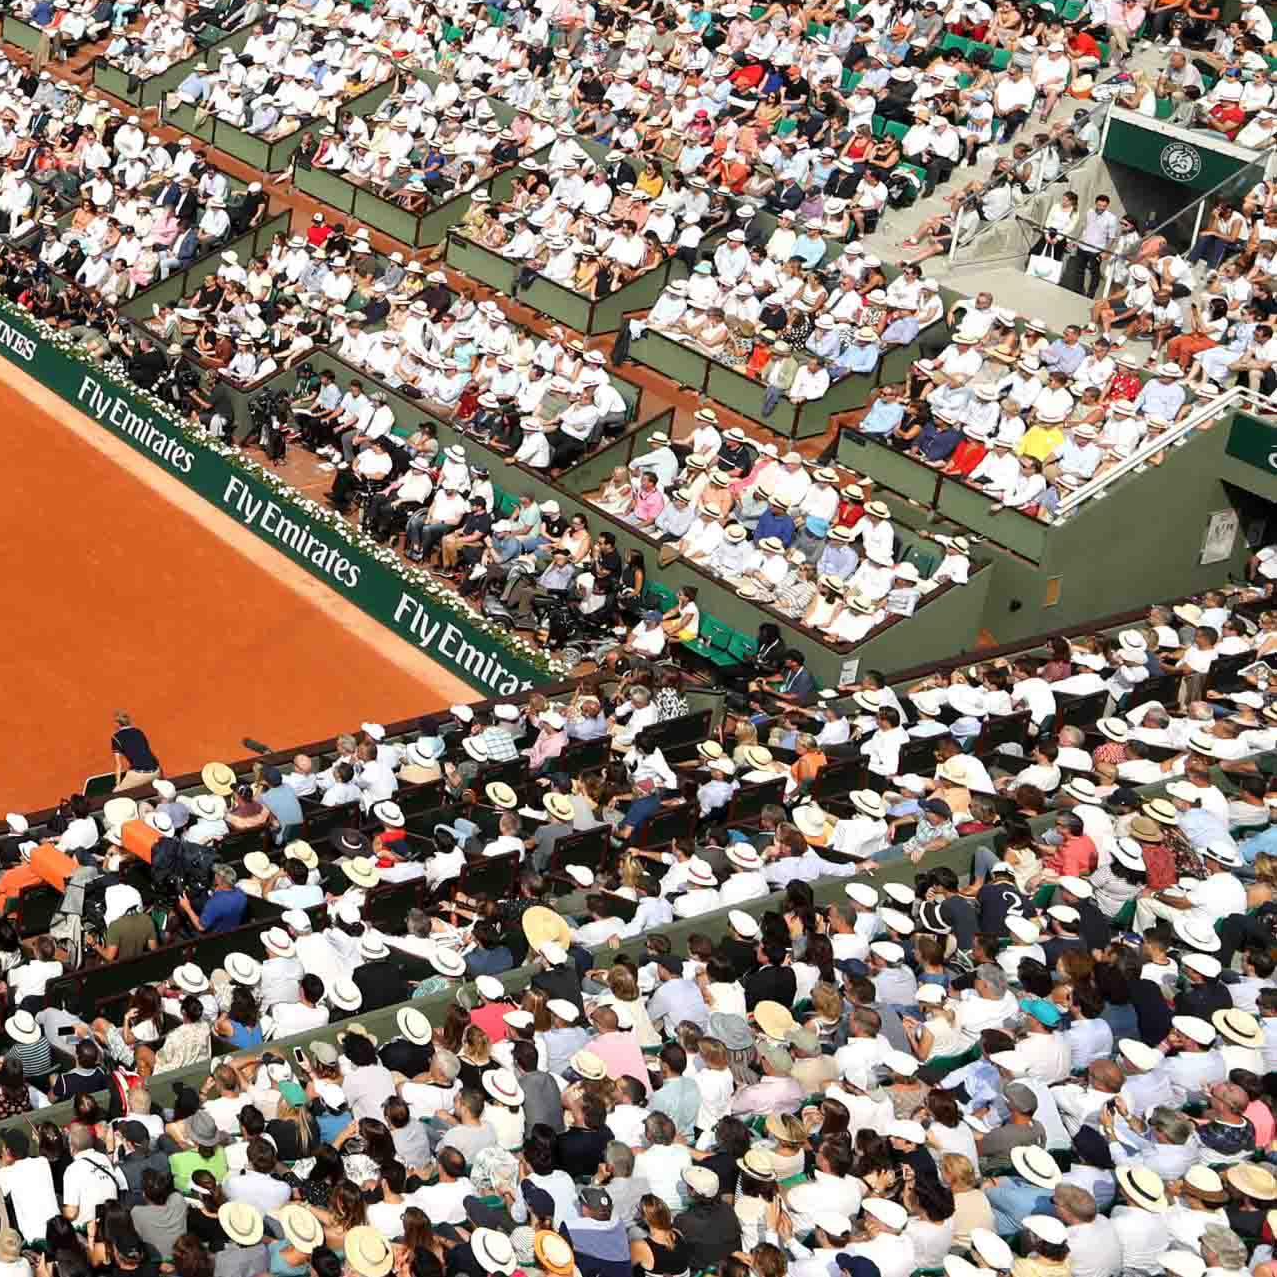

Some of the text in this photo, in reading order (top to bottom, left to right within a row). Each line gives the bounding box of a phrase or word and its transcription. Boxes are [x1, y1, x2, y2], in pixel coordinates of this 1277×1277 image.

[78, 375, 195, 473] Fly Emirates
[223, 475, 361, 588] Fly Emirates
[393, 592, 534, 697] Fly Emira
[1002, 891, 1023, 917] 2
